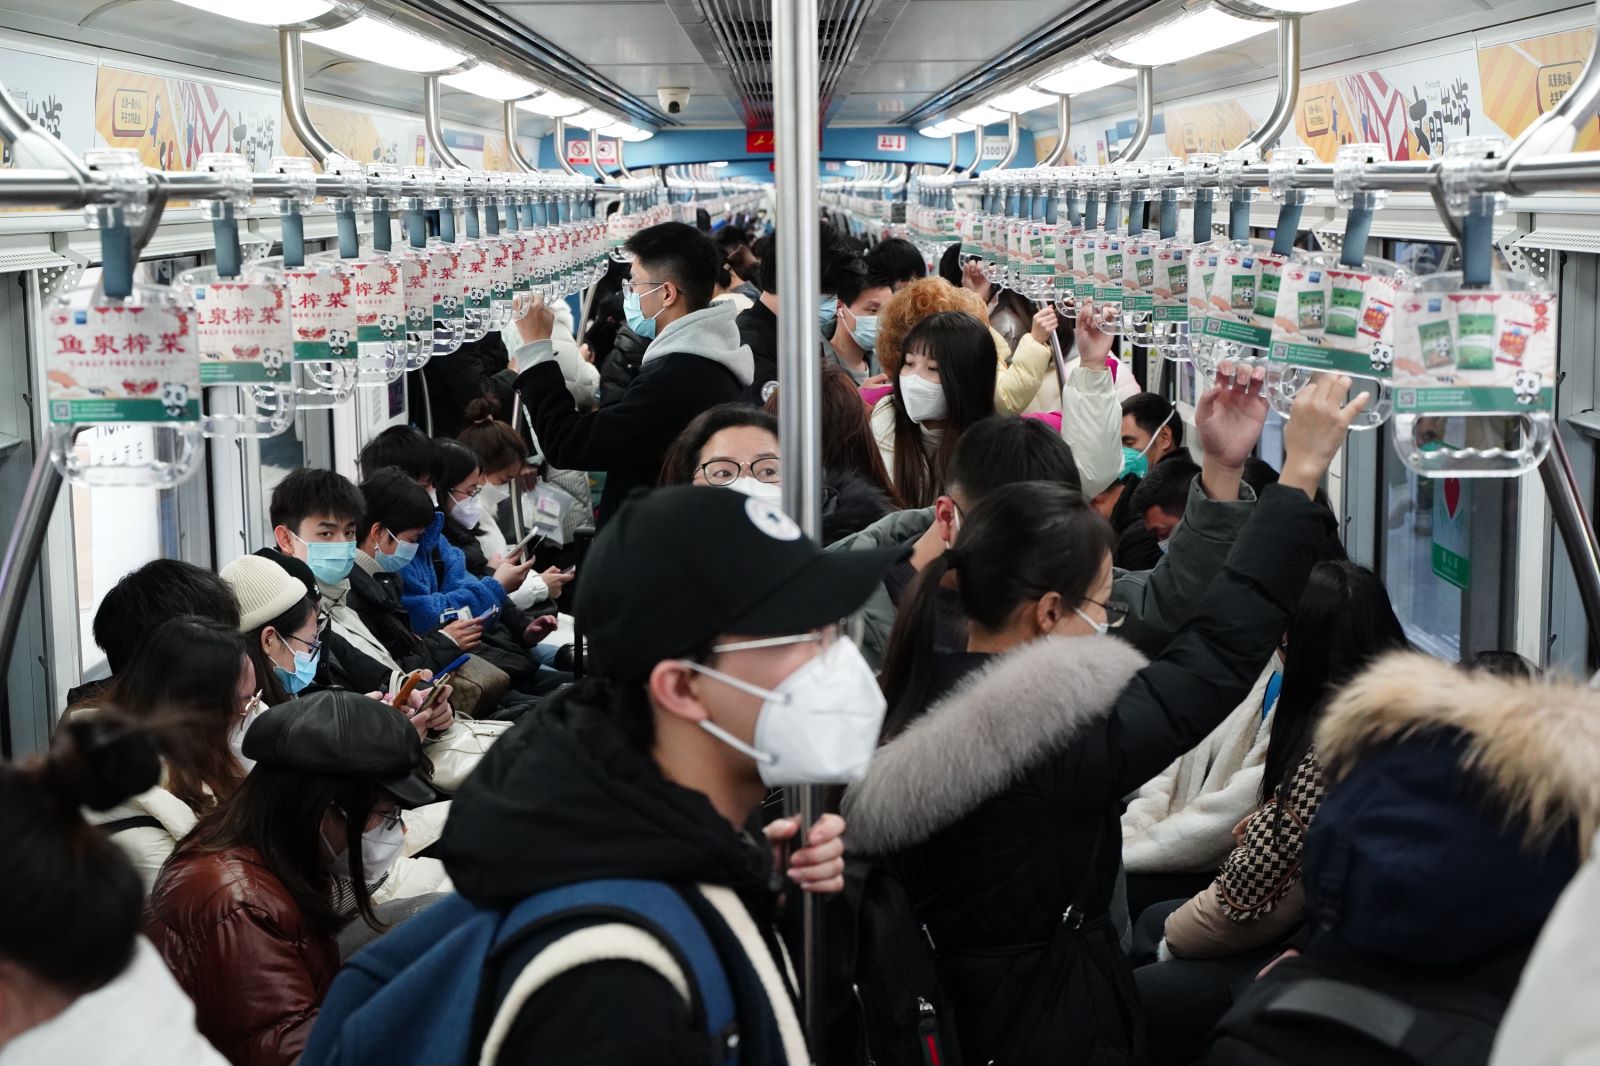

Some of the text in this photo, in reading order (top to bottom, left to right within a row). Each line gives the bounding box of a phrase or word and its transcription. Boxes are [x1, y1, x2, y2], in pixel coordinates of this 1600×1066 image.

[291, 293, 349, 310] 榨菜
[57, 333, 187, 355] 鱼泉榨菜
